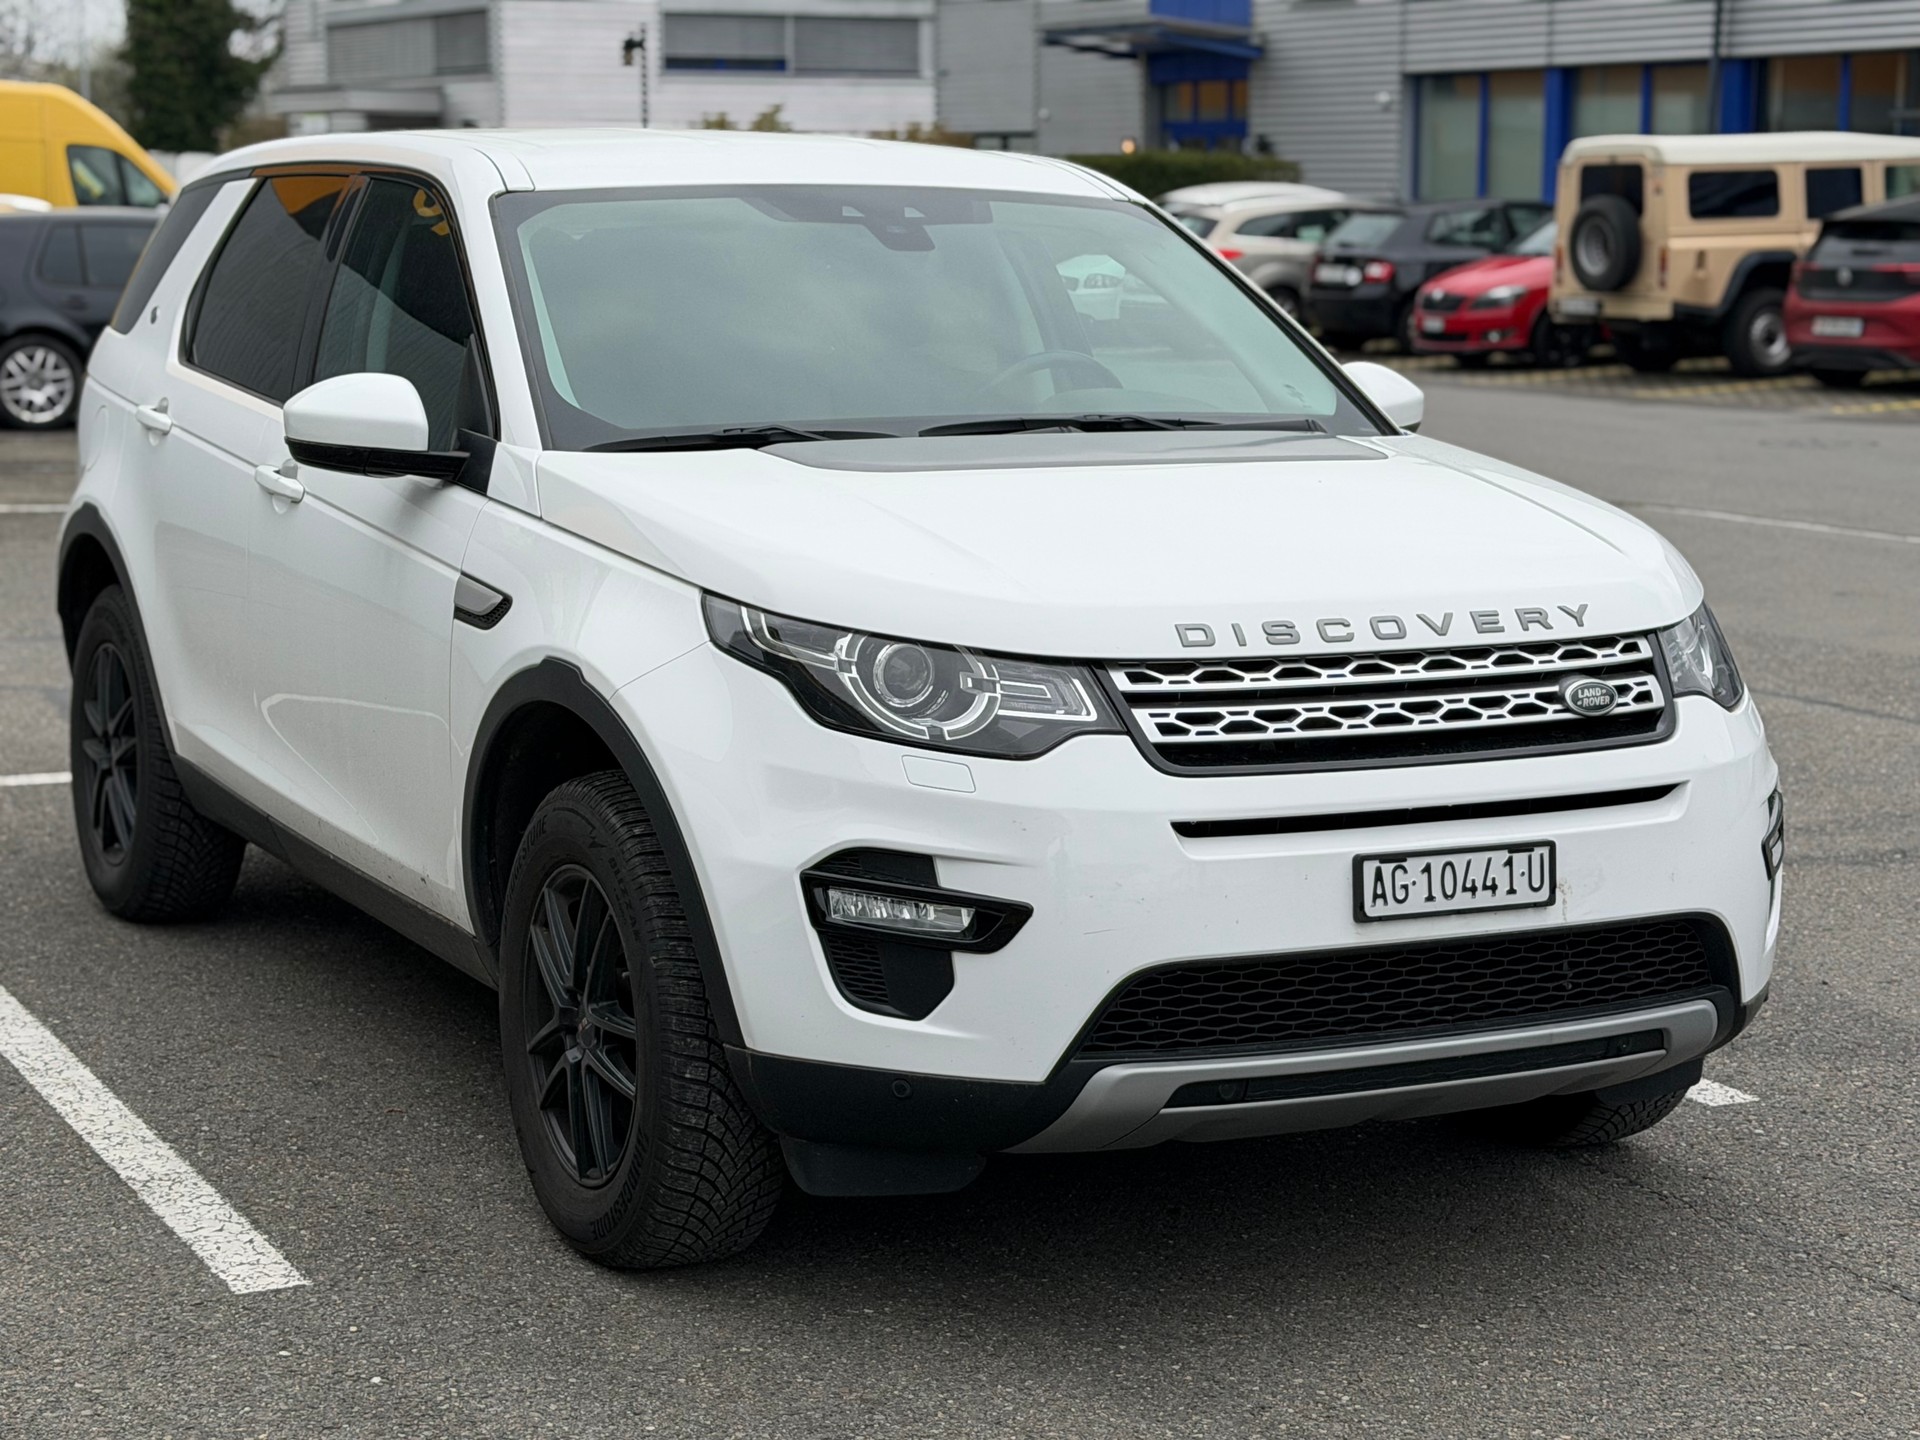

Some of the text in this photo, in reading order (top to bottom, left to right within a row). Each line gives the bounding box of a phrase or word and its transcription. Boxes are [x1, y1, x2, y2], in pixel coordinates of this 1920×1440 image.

[1174, 603, 1589, 648] DISCOVERY
[1578, 687, 1602, 699] LAND
[1582, 695, 1611, 708] ROVER
